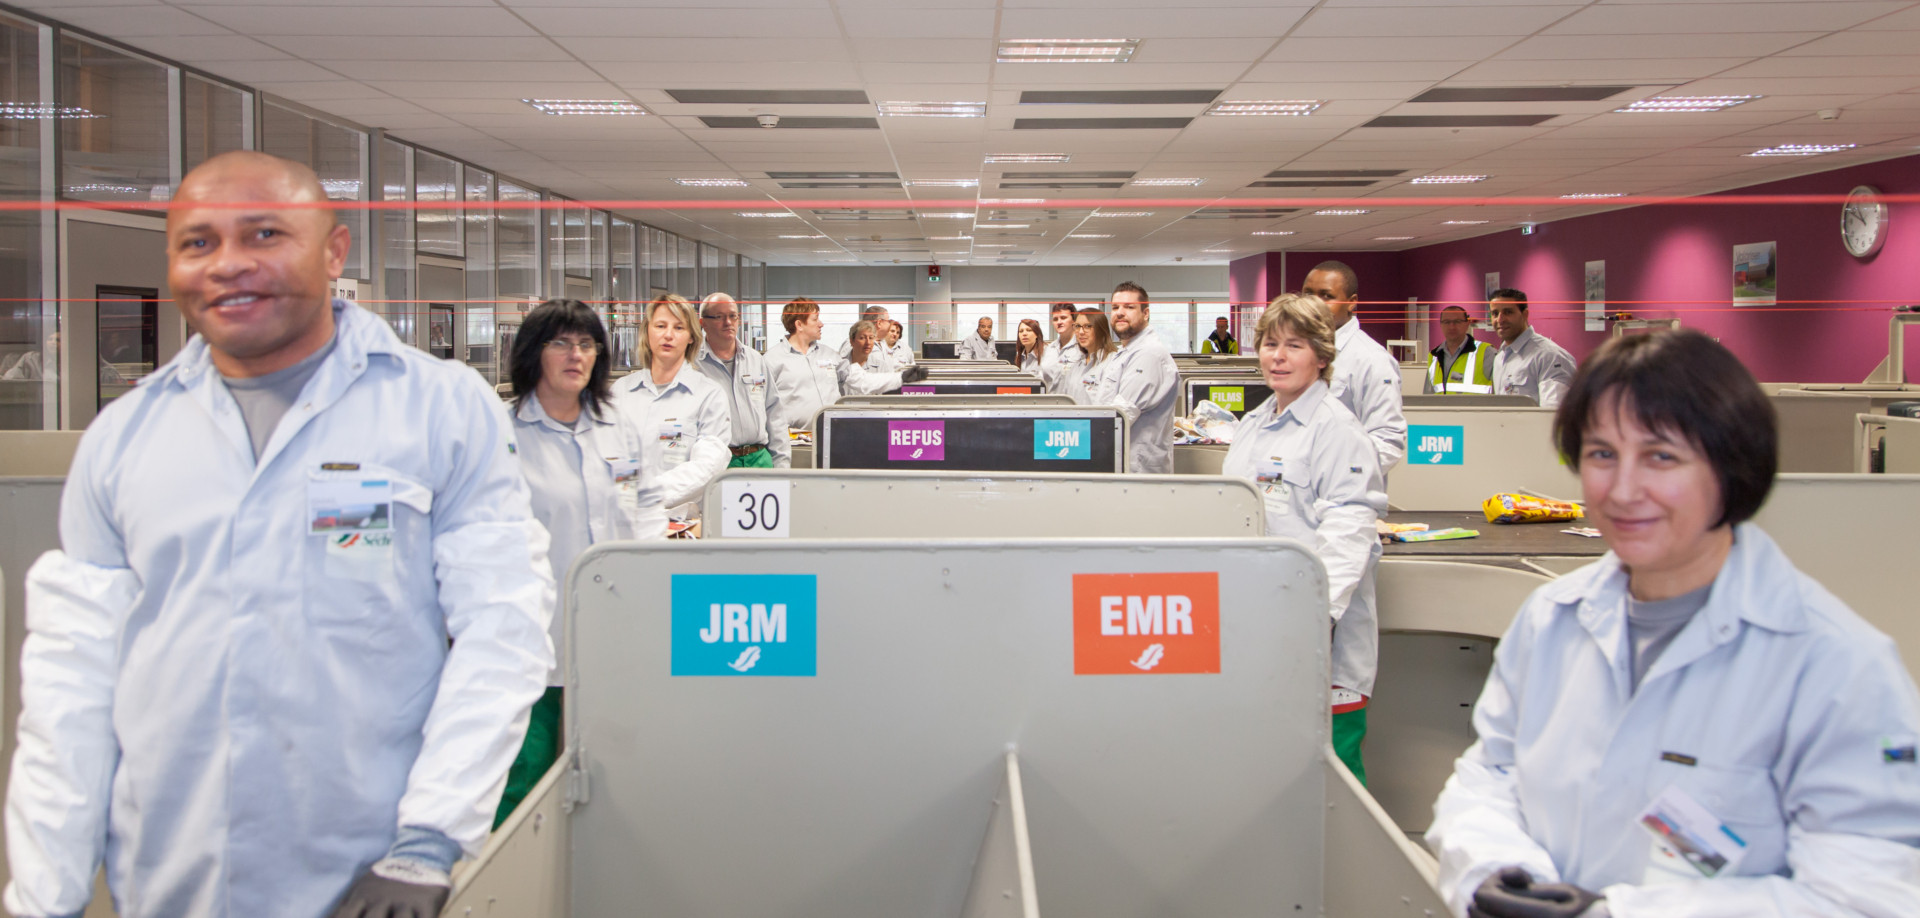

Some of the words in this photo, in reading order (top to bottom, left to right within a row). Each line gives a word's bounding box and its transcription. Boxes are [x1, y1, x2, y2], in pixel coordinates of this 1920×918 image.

[346, 289, 356, 300] JRM
[1211, 392, 1243, 403] FILMS
[890, 429, 943, 446] REFUS
[1044, 431, 1080, 447] JRM
[1417, 436, 1453, 453] JRM
[738, 492, 780, 531] 30
[699, 603, 788, 643] JRM
[1100, 595, 1194, 637] EMR
